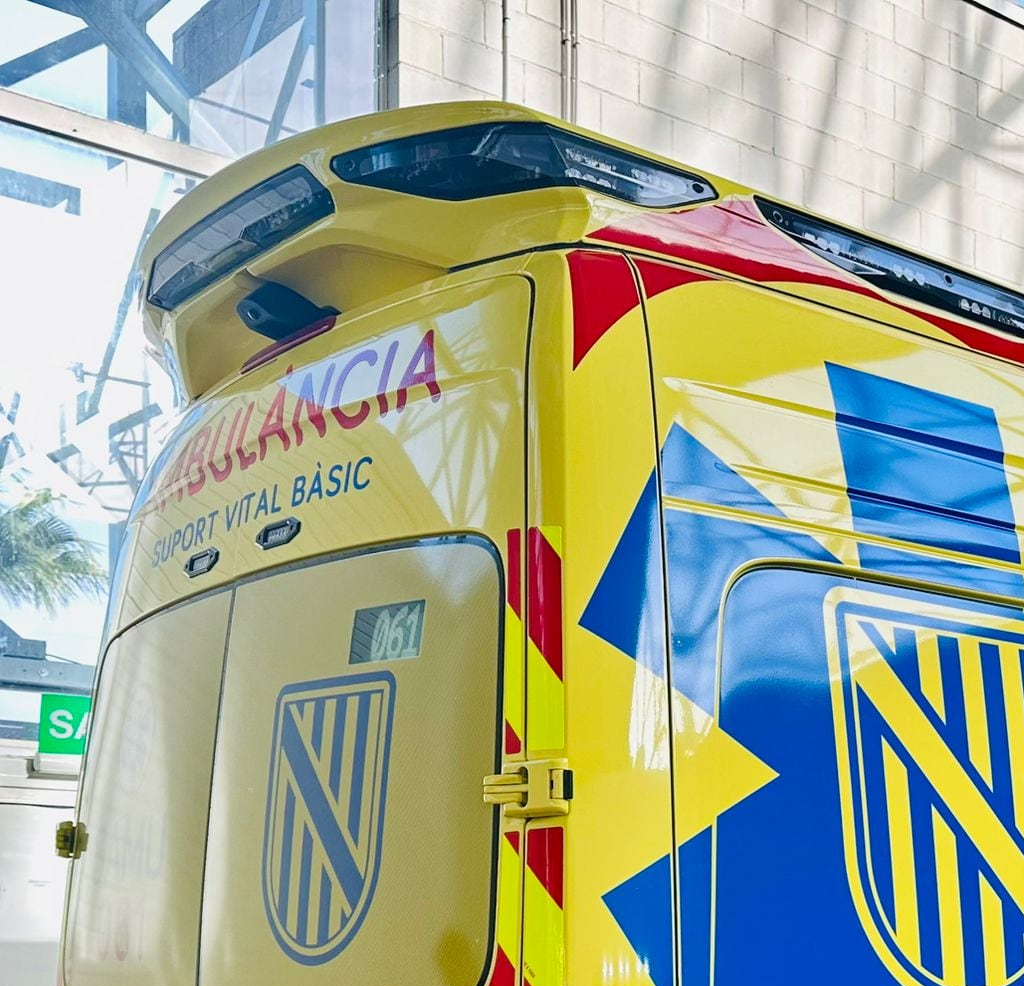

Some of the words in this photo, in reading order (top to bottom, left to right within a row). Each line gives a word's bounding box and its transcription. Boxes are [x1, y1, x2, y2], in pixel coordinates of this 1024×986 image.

[151, 508, 219, 568] SUPORT
[225, 483, 282, 532] VITAL
[291, 456, 373, 507] BÀSIC
[371, 604, 421, 661] 061
